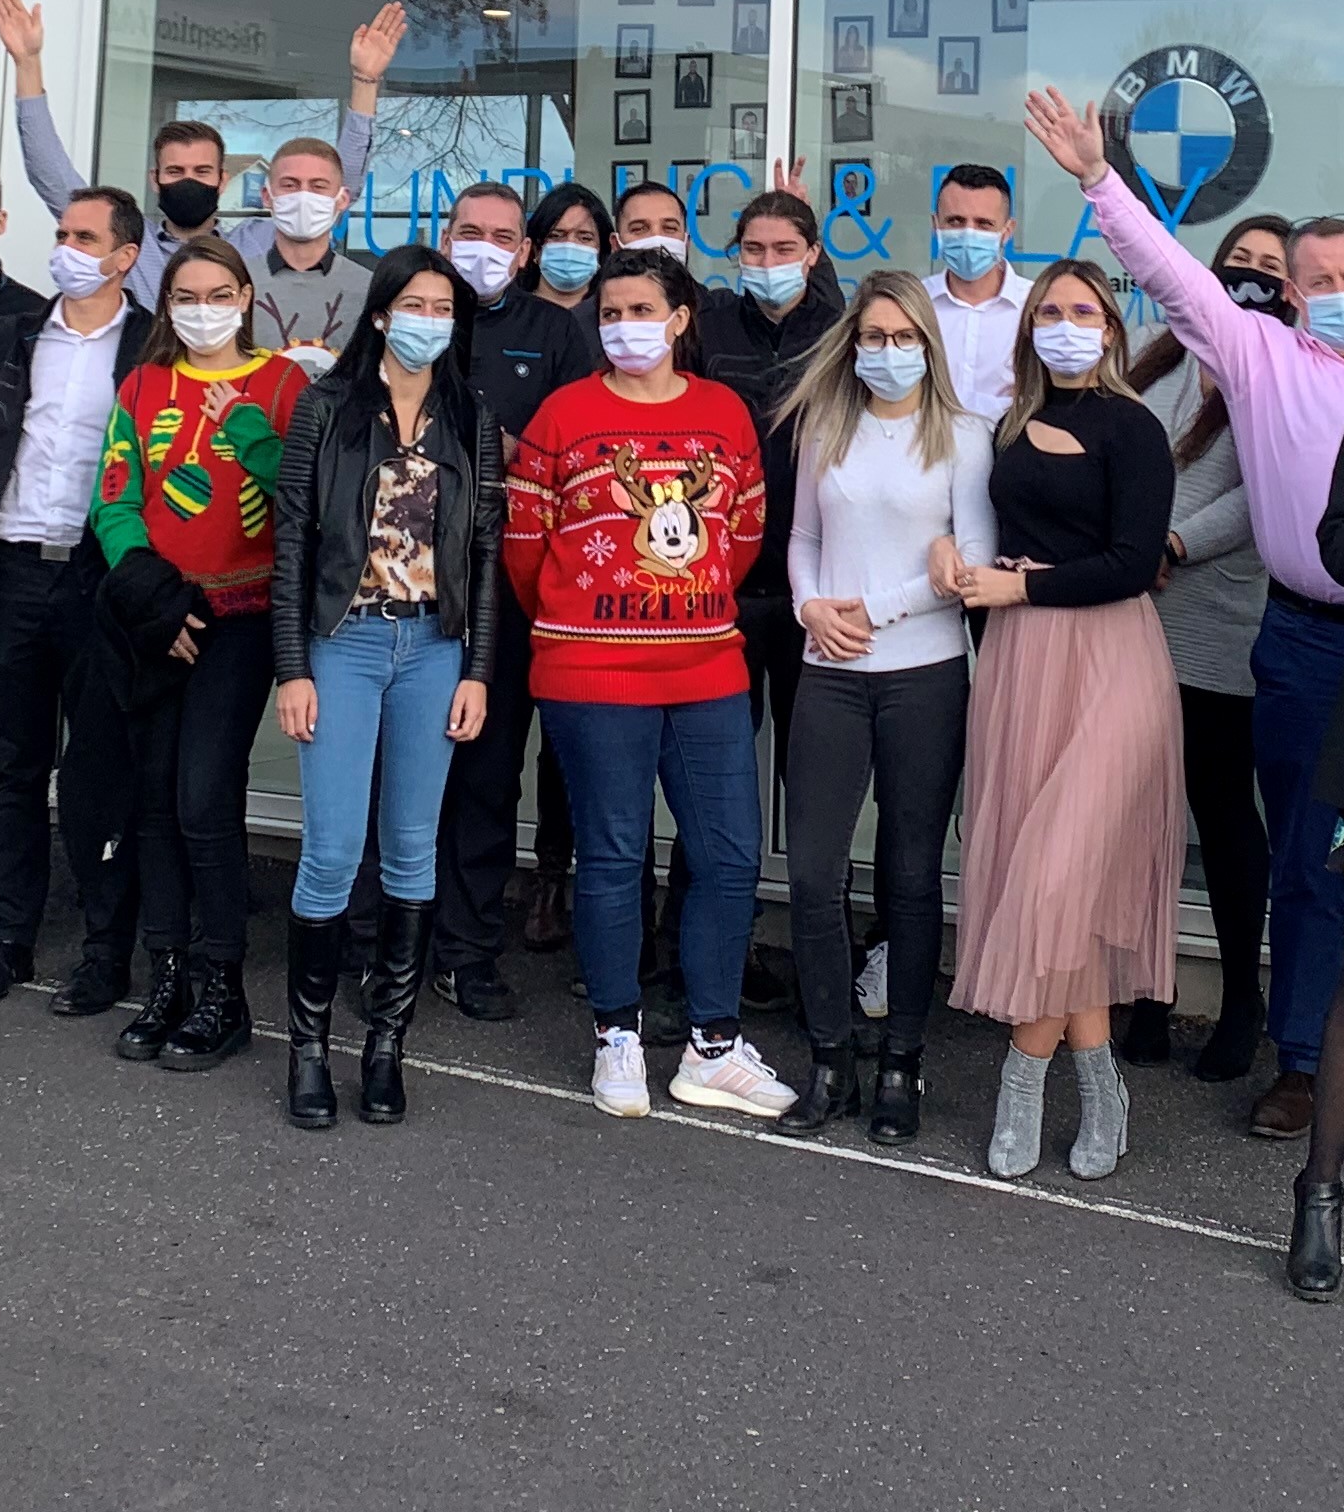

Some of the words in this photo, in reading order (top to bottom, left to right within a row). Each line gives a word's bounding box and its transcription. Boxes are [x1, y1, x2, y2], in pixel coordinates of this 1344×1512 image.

[1115, 50, 1258, 106] BMW
[822, 162, 894, 261] &
[633, 568, 713, 611] Jingle
